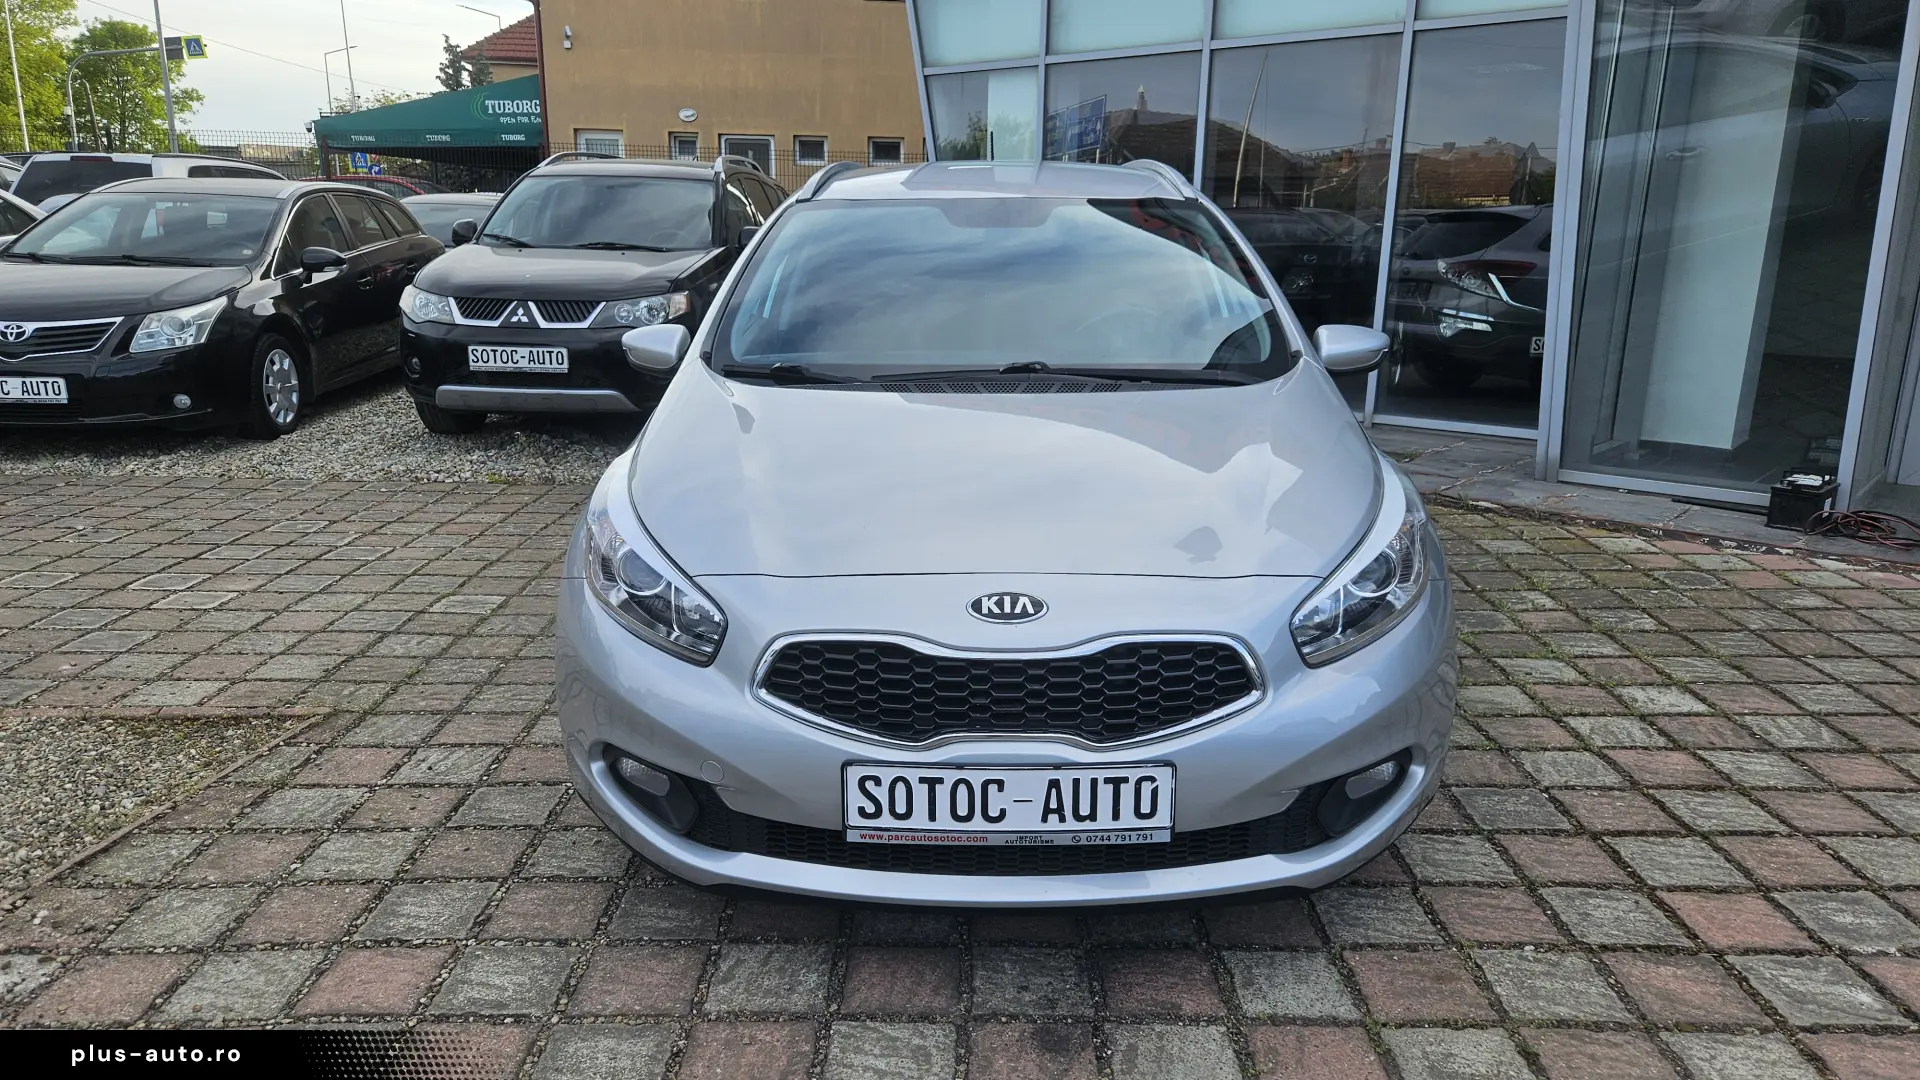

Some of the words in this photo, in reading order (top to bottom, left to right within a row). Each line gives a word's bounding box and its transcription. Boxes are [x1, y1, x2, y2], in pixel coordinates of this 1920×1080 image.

[485, 99, 541, 114] TUBORG
[499, 116, 516, 124] OPEN
[471, 348, 565, 366] SOTOC-AUTO
[980, 595, 1035, 614] KIA
[859, 832, 988, 843] www.parcautosotoc.com
[1085, 835, 1111, 843] 0744
[1114, 834, 1132, 842] 791
[1135, 833, 1154, 841] 791
